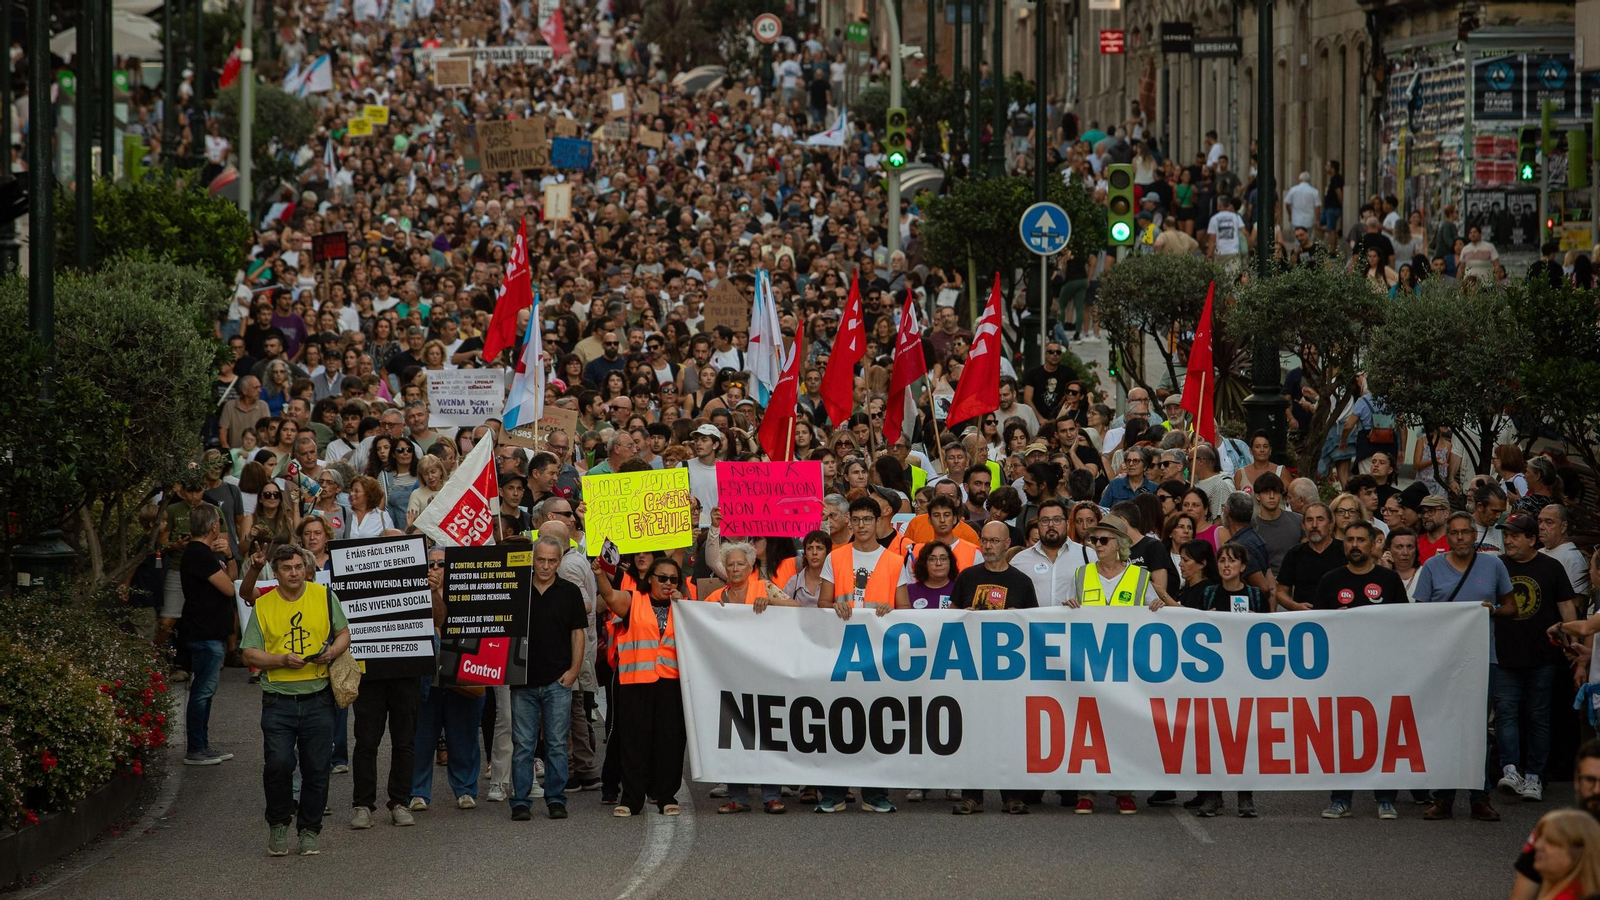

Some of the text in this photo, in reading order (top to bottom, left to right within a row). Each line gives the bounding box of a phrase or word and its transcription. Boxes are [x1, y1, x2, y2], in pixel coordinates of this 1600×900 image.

[759, 22, 775, 32] 40
[1194, 42, 1238, 51] BERSHKA
[487, 135, 512, 148] SOIS
[730, 465, 770, 477] NON
[590, 472, 686, 503] LUME LUME
[588, 498, 628, 522] LUME
[723, 502, 754, 515] NON
[446, 505, 476, 538] PSG
[460, 508, 492, 546] PSOE
[352, 549, 366, 558] MÁIS
[368, 547, 384, 557] FÁCIL
[385, 544, 410, 554] ENTRAR
[393, 556, 416, 566] BENITO
[331, 578, 428, 590] QUE ATOPAR VIVENDA EN VIGO
[349, 595, 430, 613] MÁIS VIVENDA SOCIAL
[349, 622, 423, 635] LUGUEIROS MÁIS BARATOS
[349, 644, 379, 654] CONTROL
[392, 644, 418, 652] PREZOS
[830, 622, 1330, 683] ACABEMOS CO
[463, 660, 501, 679] Control
[718, 690, 1426, 774] NEGOCIO DA VIVENDA
